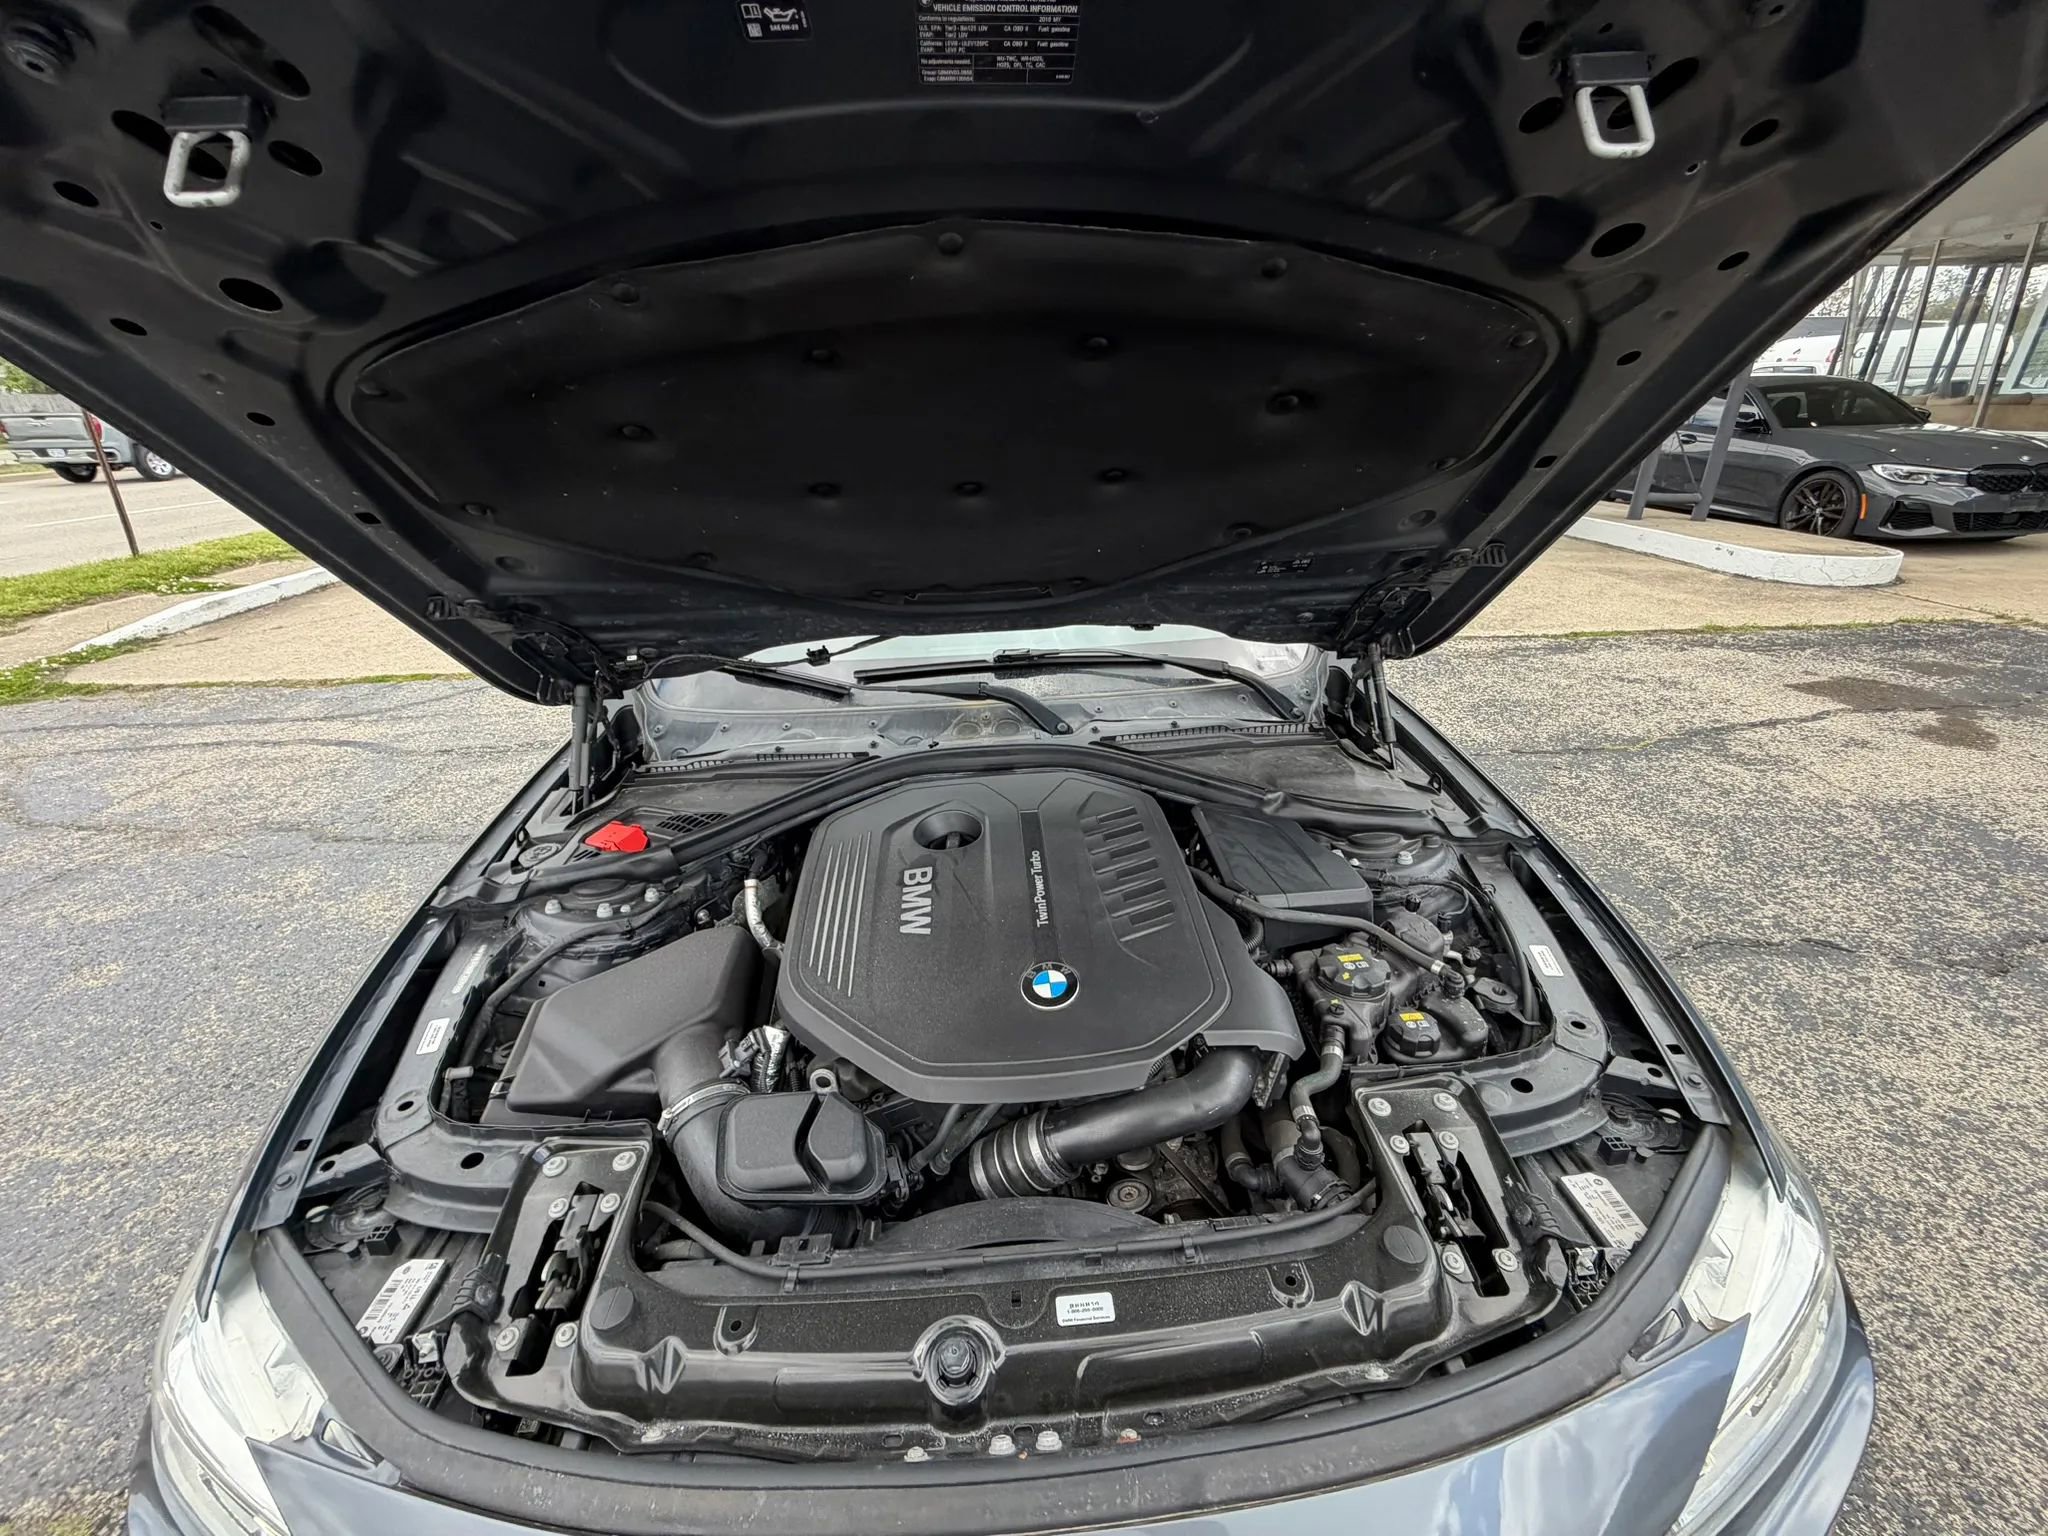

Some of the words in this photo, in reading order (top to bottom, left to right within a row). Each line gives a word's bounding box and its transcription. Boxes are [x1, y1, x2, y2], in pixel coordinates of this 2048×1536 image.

[933, 3, 961, 12] VEHICLE
[962, 4, 996, 12] EMISSION
[997, 4, 1029, 12] CONTROL
[1029, 5, 1078, 13] INFORMATION
[1030, 850, 1042, 875] Turbo
[900, 866, 933, 935] BMW
[1034, 873, 1048, 928] TwinPower
[1026, 962, 1071, 979] BMW
